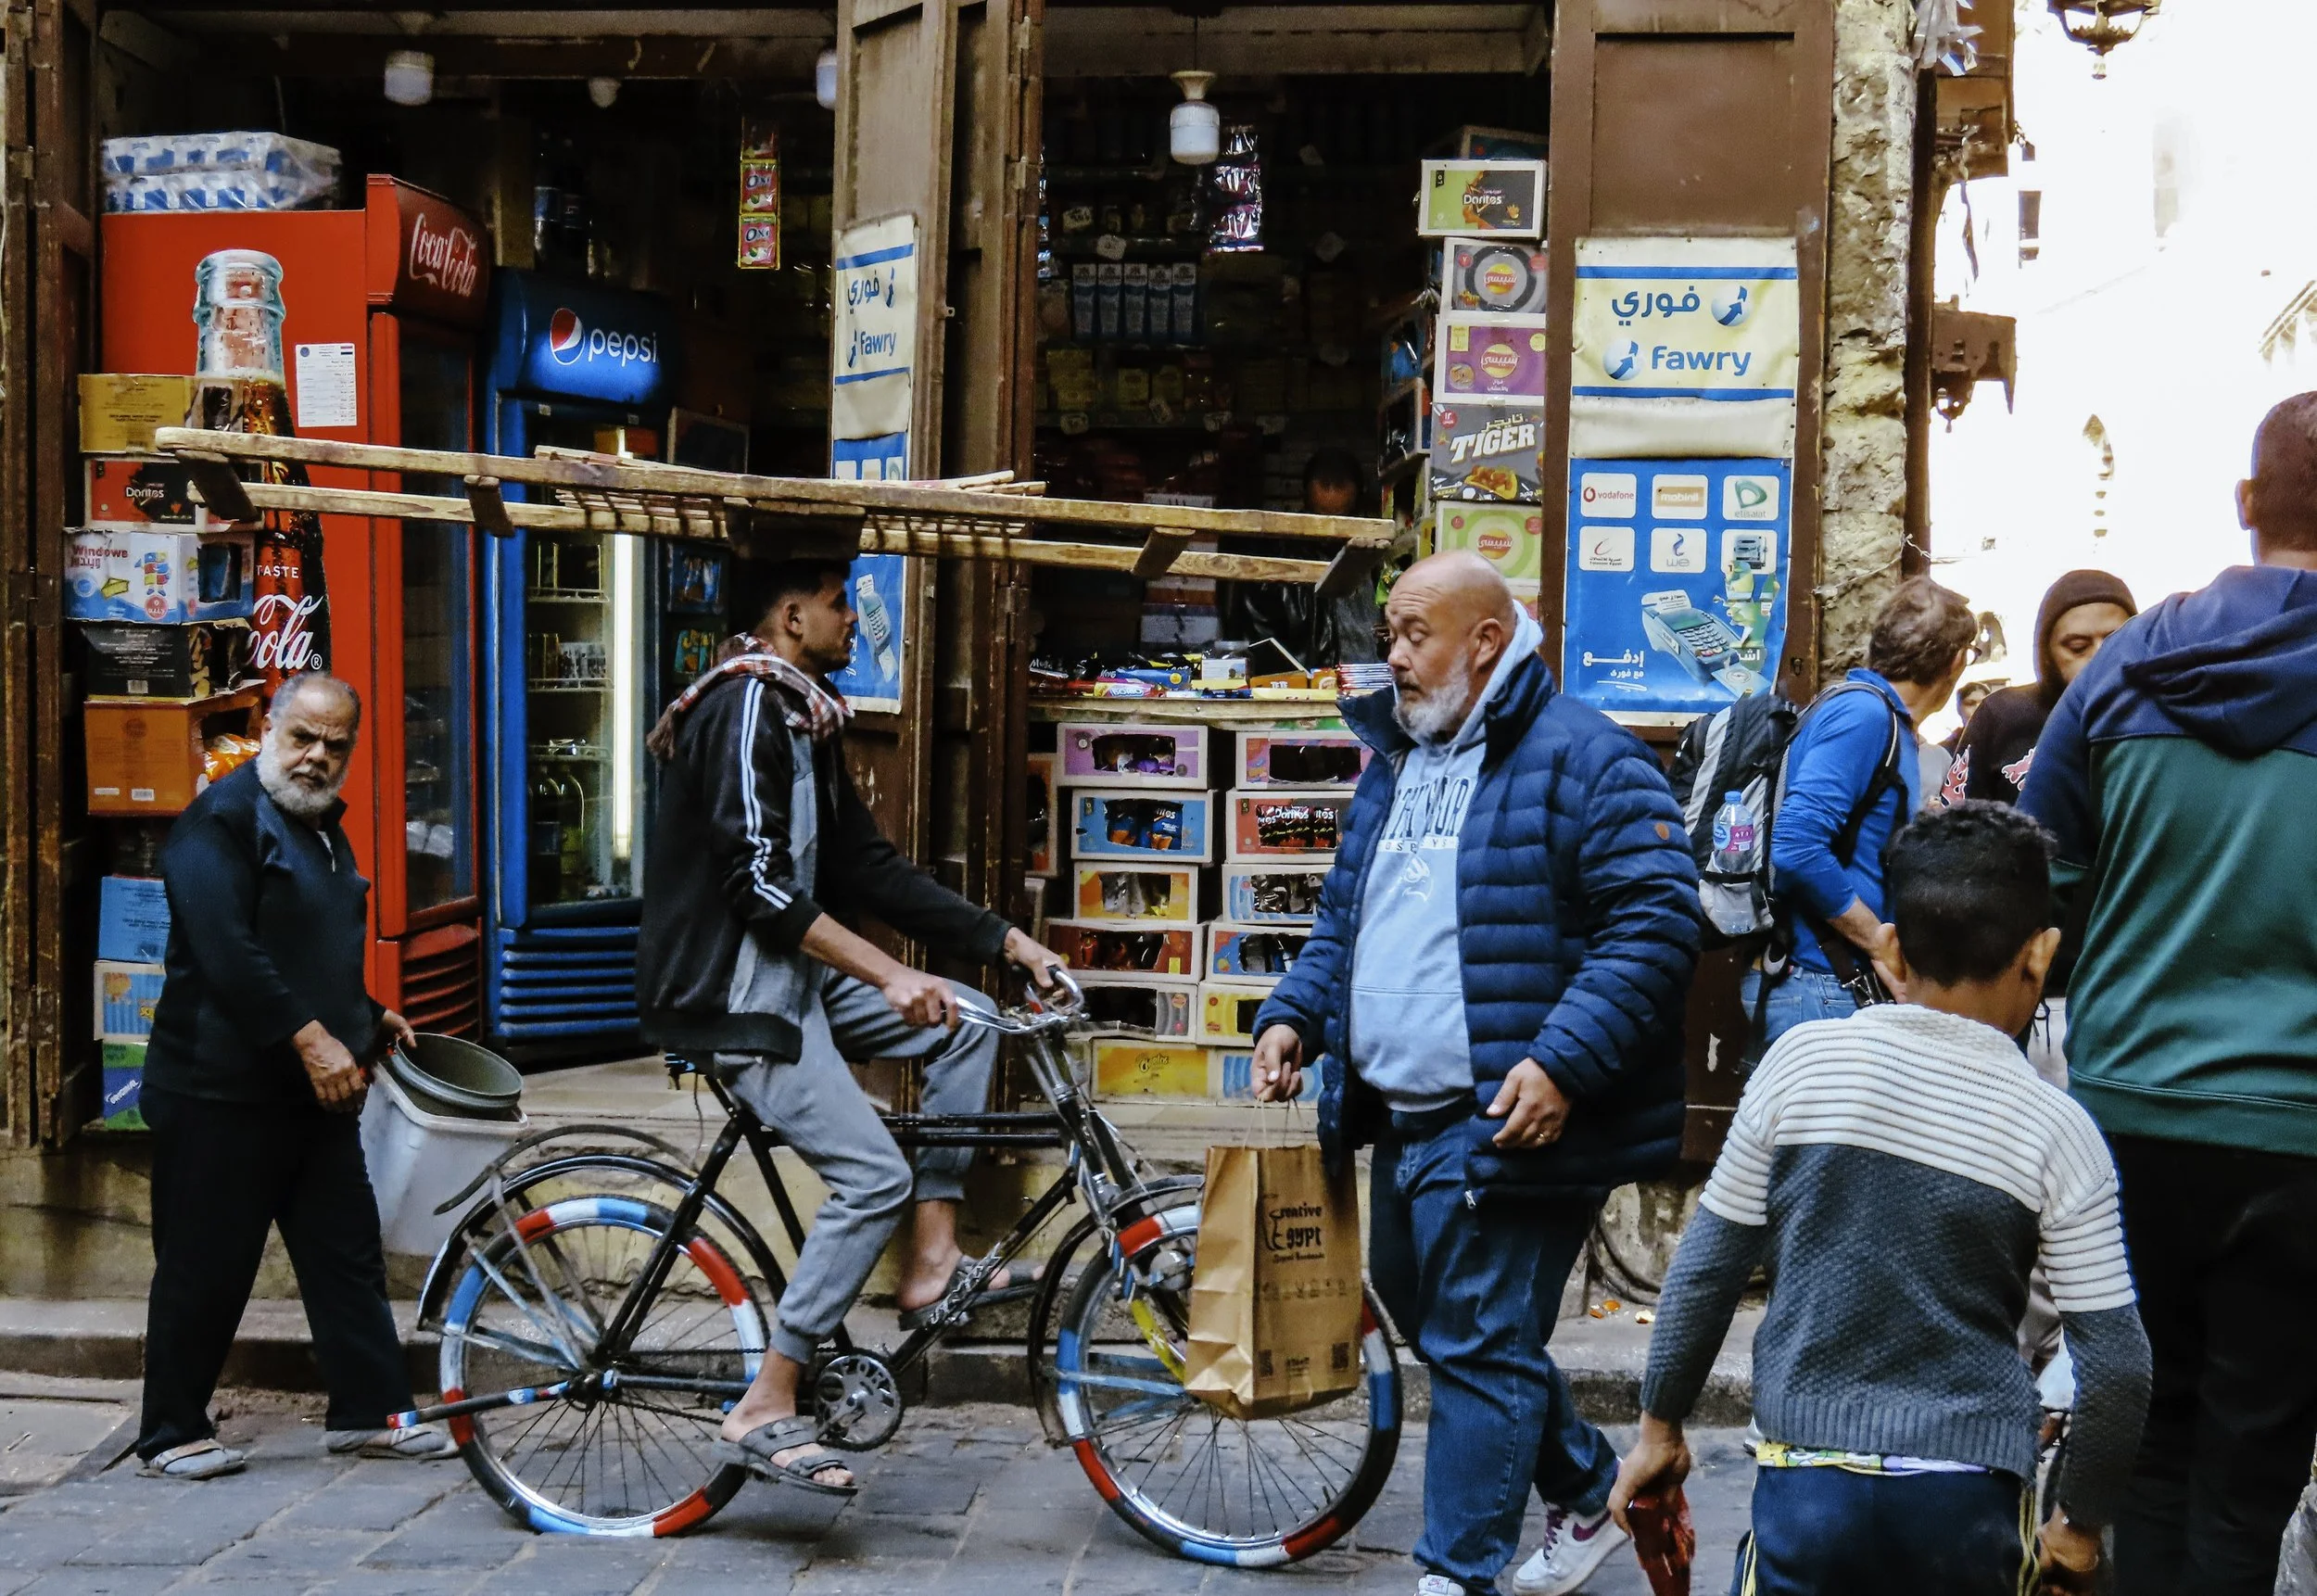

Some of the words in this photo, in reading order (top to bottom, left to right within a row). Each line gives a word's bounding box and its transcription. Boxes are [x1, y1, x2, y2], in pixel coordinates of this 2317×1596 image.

[1463, 194, 1502, 205] Doritos
[409, 212, 478, 298] Coca-Cola
[847, 269, 880, 314] فوري
[1611, 285, 1701, 326] فوري
[588, 327, 657, 368] pepsi
[1652, 345, 1752, 376] fawry
[1480, 412, 1525, 433] تايجر
[1450, 424, 1536, 464] TIGER
[125, 487, 165, 499] Doritos
[1597, 490, 1634, 500] vodafone
[1660, 492, 1699, 502] mobinil
[257, 564, 299, 578] TASTE
[1272, 1227, 1322, 1250] Egypt
